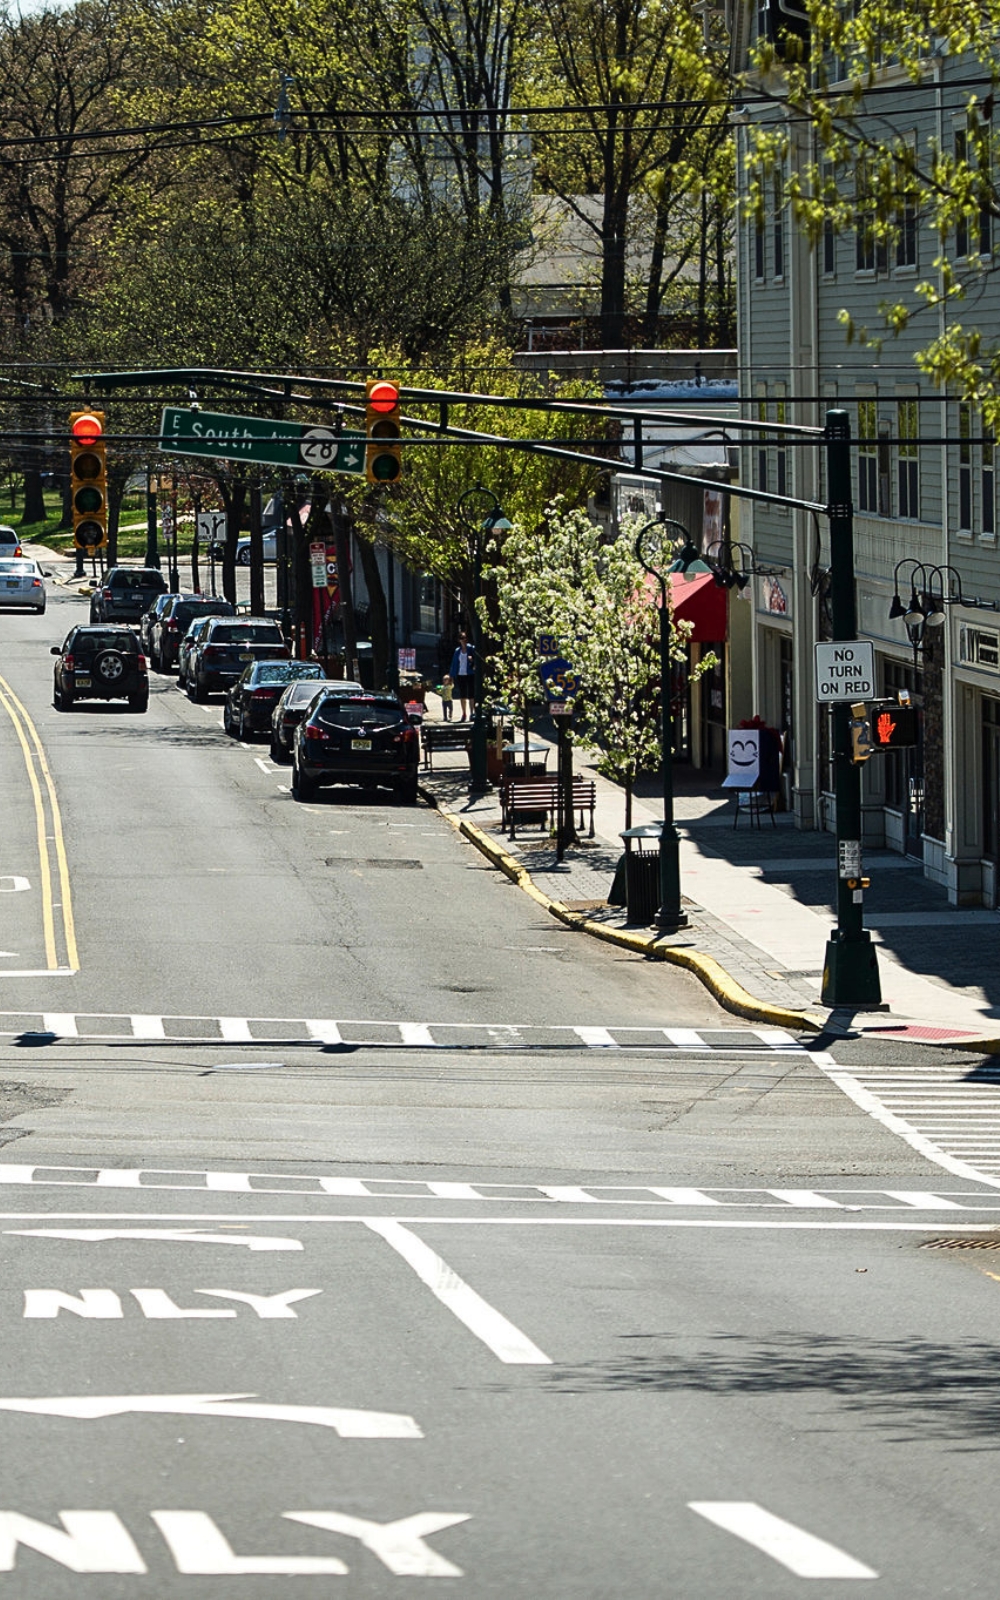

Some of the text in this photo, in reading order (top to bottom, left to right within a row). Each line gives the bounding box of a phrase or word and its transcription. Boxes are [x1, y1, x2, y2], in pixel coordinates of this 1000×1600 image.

[172, 414, 181, 429] E
[191, 422, 253, 450] South
[304, 435, 333, 460] 28
[834, 649, 854, 662] NO
[828, 665, 862, 678] TURN
[546, 674, 576, 691] 655
[821, 681, 871, 695] ON RED
[23, 1288, 324, 1318] NLY
[0, 1510, 473, 1576] NLY
